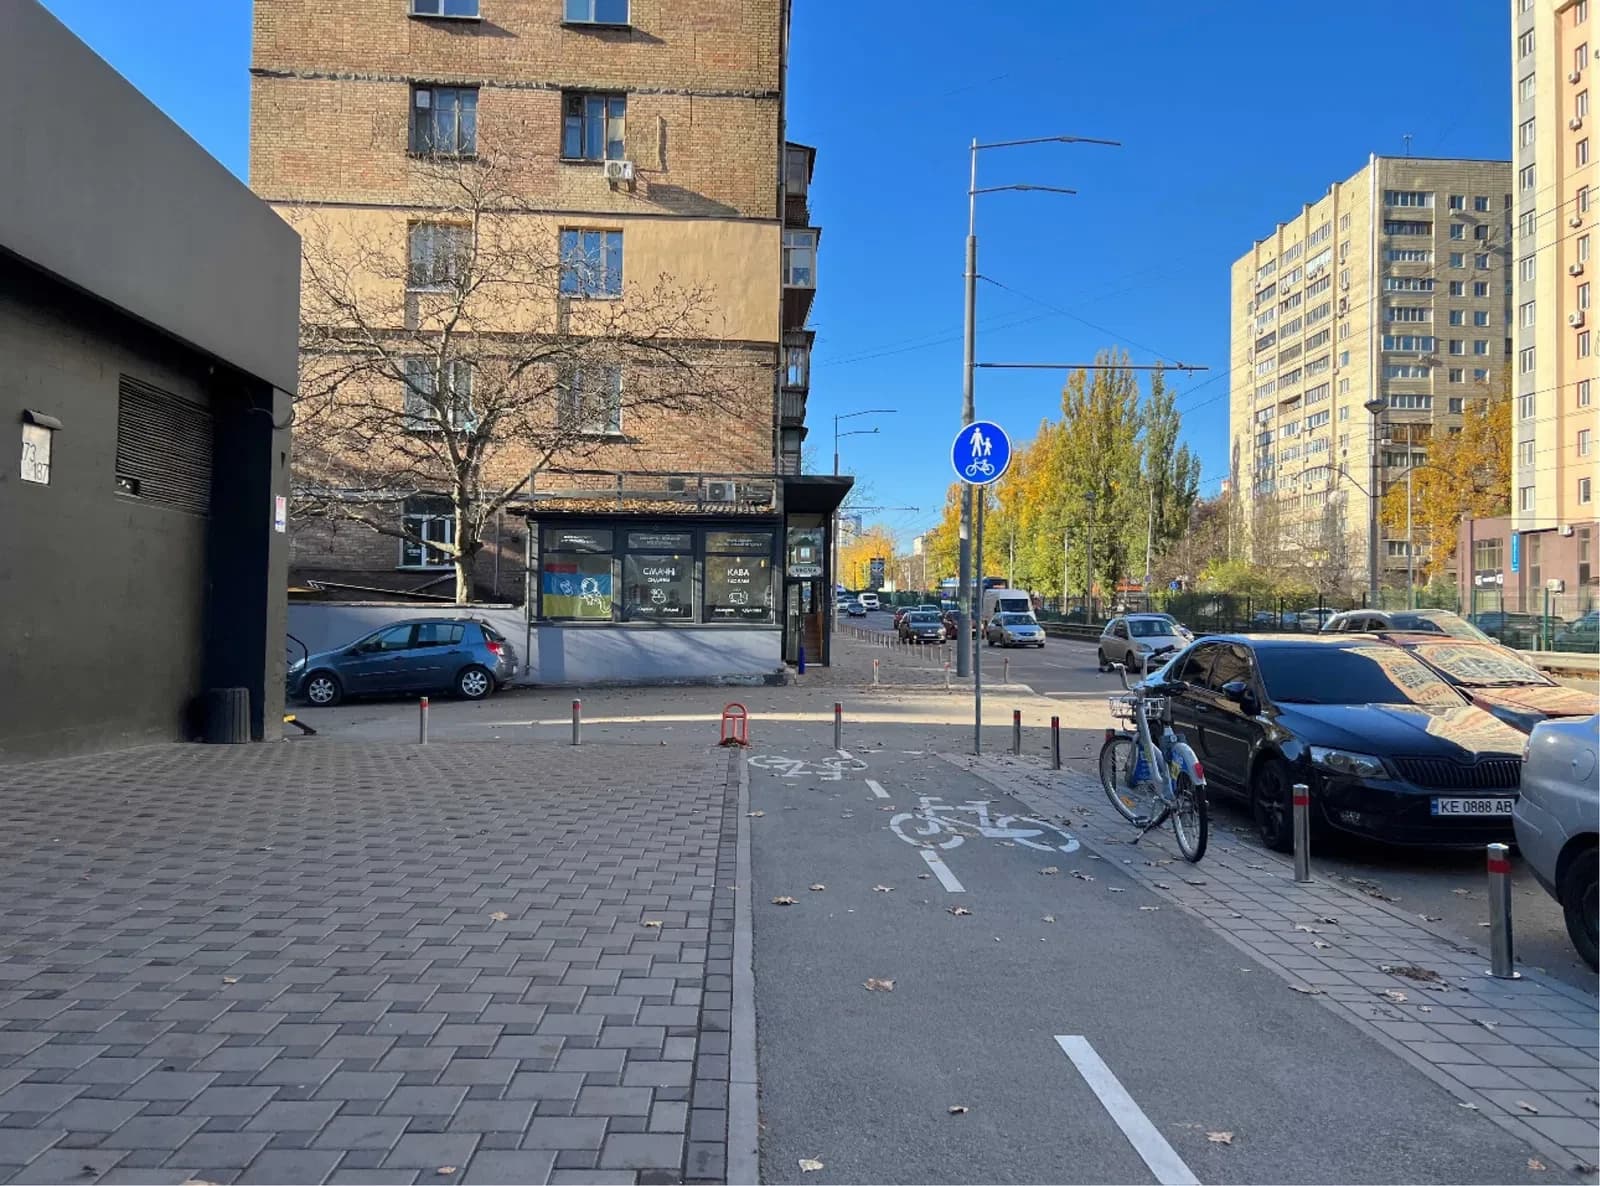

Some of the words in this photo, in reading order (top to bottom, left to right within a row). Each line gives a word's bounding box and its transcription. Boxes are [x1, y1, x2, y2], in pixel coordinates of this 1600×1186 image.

[1441, 801, 1460, 813] KE
[1463, 801, 1492, 813] 0888
[1495, 801, 1512, 813] AB
